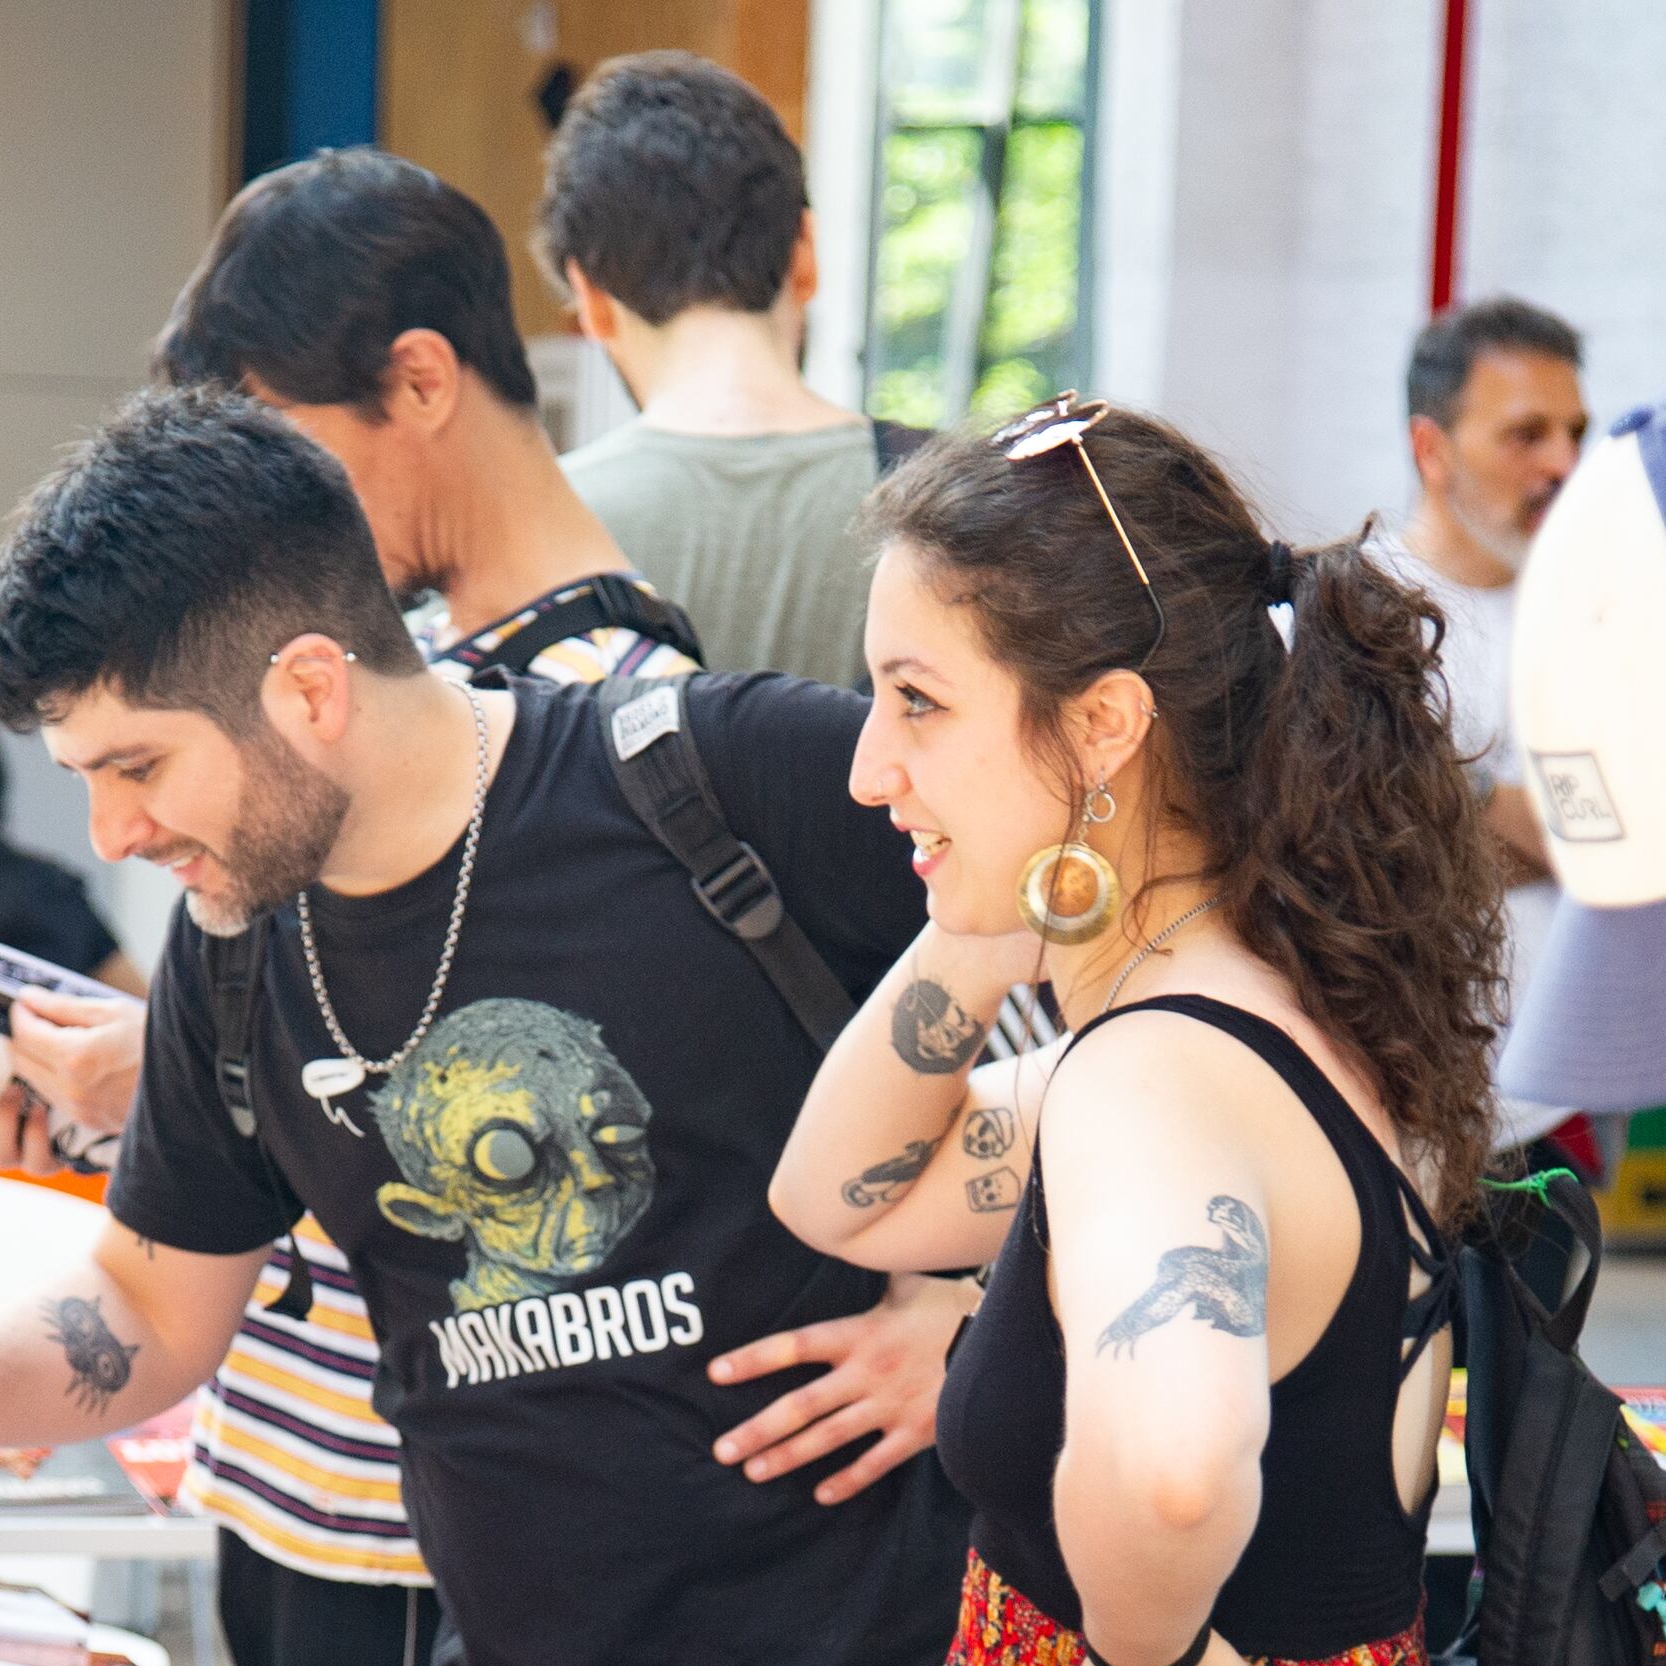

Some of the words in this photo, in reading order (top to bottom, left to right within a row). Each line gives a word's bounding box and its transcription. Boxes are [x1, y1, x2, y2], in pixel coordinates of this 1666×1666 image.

[1550, 773, 1580, 798] RIP
[1560, 799, 1612, 822] CURL
[428, 1270, 705, 1389] MAKABROS
